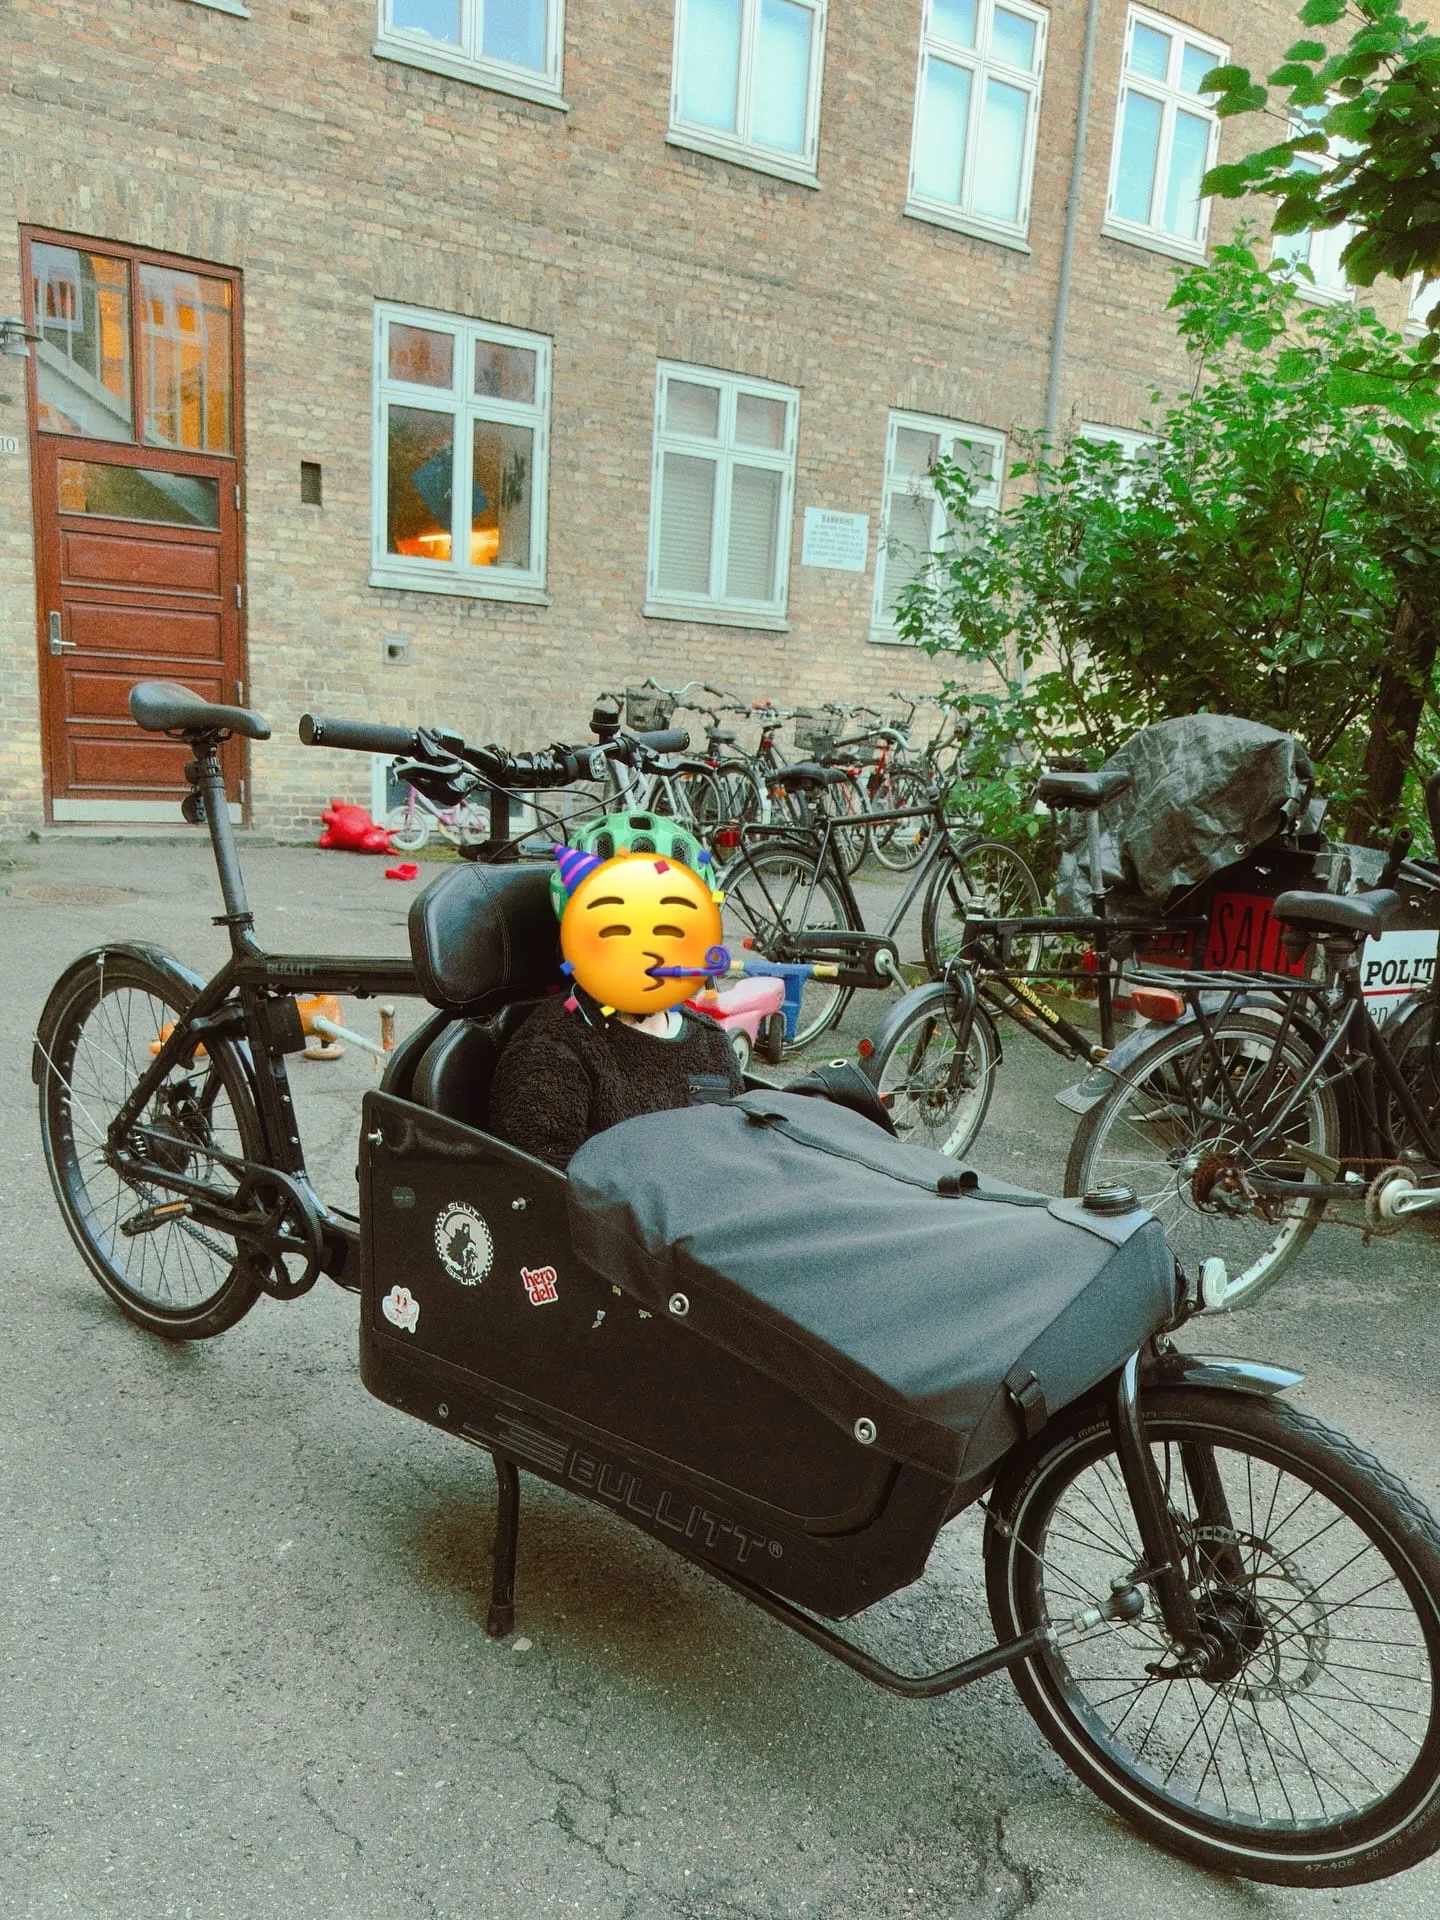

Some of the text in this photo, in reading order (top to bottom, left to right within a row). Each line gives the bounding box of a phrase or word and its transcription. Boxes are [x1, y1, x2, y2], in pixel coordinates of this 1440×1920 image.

[1, 437, 15, 452] 10
[447, 1201, 480, 1218] SLUT
[444, 1264, 483, 1287] SPURT
[522, 1268, 556, 1288] hero
[530, 1285, 557, 1304] deli
[1304, 1857, 1356, 1873] 47-406
